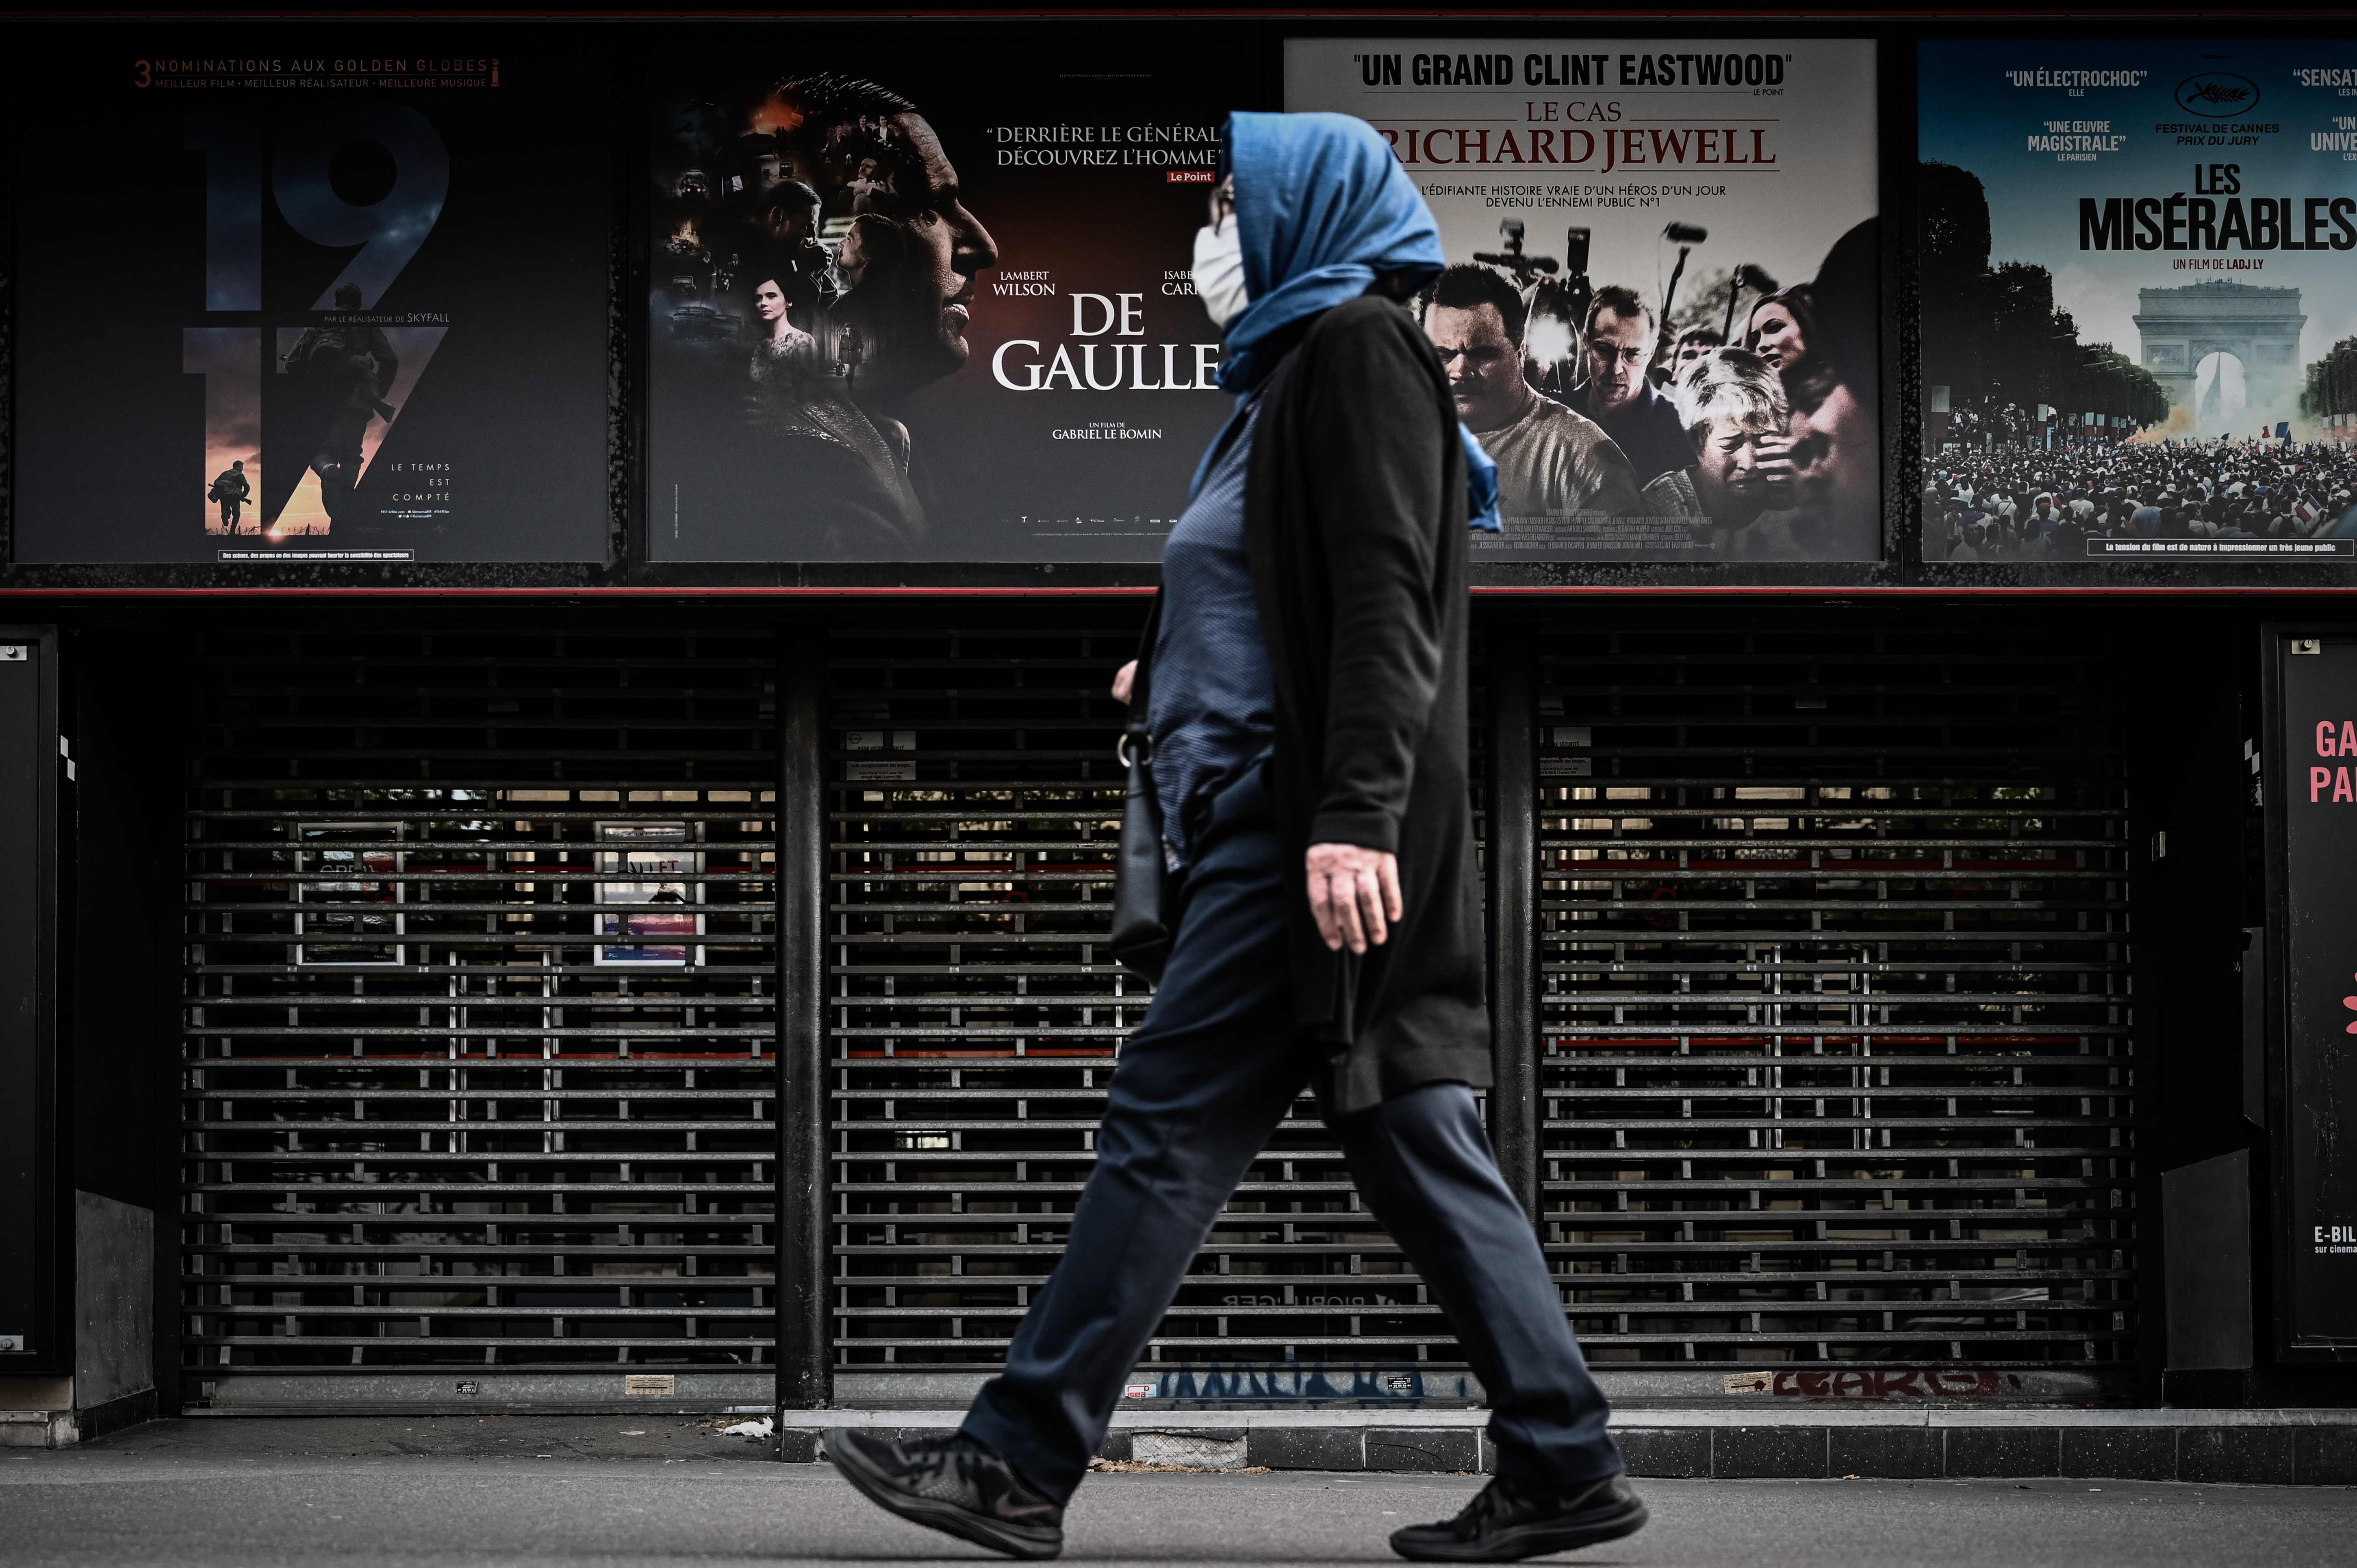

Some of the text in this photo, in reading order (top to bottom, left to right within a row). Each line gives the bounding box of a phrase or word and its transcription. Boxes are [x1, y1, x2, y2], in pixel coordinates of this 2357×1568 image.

[156, 60, 281, 72] NOMINATIONS
[291, 60, 325, 72] AUX
[335, 60, 406, 72] GOLDEN
[417, 60, 486, 71] GLOBES
[1354, 54, 1792, 86] "UN GRAND CLINT EASTWOOD"
[156, 78, 486, 88] MEILLEUR FILM MEILLEUR RÉALISATEUR MEILLEURE MUSIQUE
[2005, 66, 2147, 87] “UN ÉLECTROCHOC”
[1526, 102, 1621, 122] LE CAS
[2044, 121, 2110, 133] “UNE ŒUVRE
[2155, 124, 2279, 133] FESTIVAL DE CANNES
[2332, 116, 2356, 130] “UN
[1101, 127, 1121, 142] LE
[1127, 123, 1222, 143] GÉNÉRAL,
[2028, 135, 2126, 151] MAGISTRALE”
[2177, 136, 2260, 145] PRIX DU JURY
[997, 146, 1118, 165] DÉCOUVREZ
[1601, 128, 1776, 170] JEWELL
[1184, 173, 1211, 181] Point
[2195, 163, 2240, 195] LES
[1422, 183, 1726, 196] L’ÉDIFIANTE HISTOIRE VRAIE D’UN HÉROS D’UN JOUR
[1486, 197, 1659, 207] DEVENU L’ENNEMI PUBLIC N°1
[2079, 192, 2357, 251] MISÉRABLES
[2173, 259, 2264, 270] UN FILM DE LADJ LY
[1001, 271, 1049, 280] LAMBERT
[992, 283, 1055, 296] WILSON
[407, 313, 450, 322] SKYFALL
[1068, 293, 1144, 336] DE
[992, 340, 1220, 391] GAULLE
[1053, 429, 1161, 439] GABRIEL LE BOMIN
[393, 492, 449, 501] COMPTÉ
[2106, 543, 2114, 551] La
[2115, 543, 2140, 551] tension
[2142, 543, 2151, 551] du
[2213, 543, 2218, 551] à
[2219, 543, 2268, 552] impressionner
[2279, 543, 2293, 551] très
[2294, 544, 2313, 552] jeune
[2315, 544, 2336, 552] public
[2316, 720, 2357, 757] GA
[2310, 766, 2357, 802] PA
